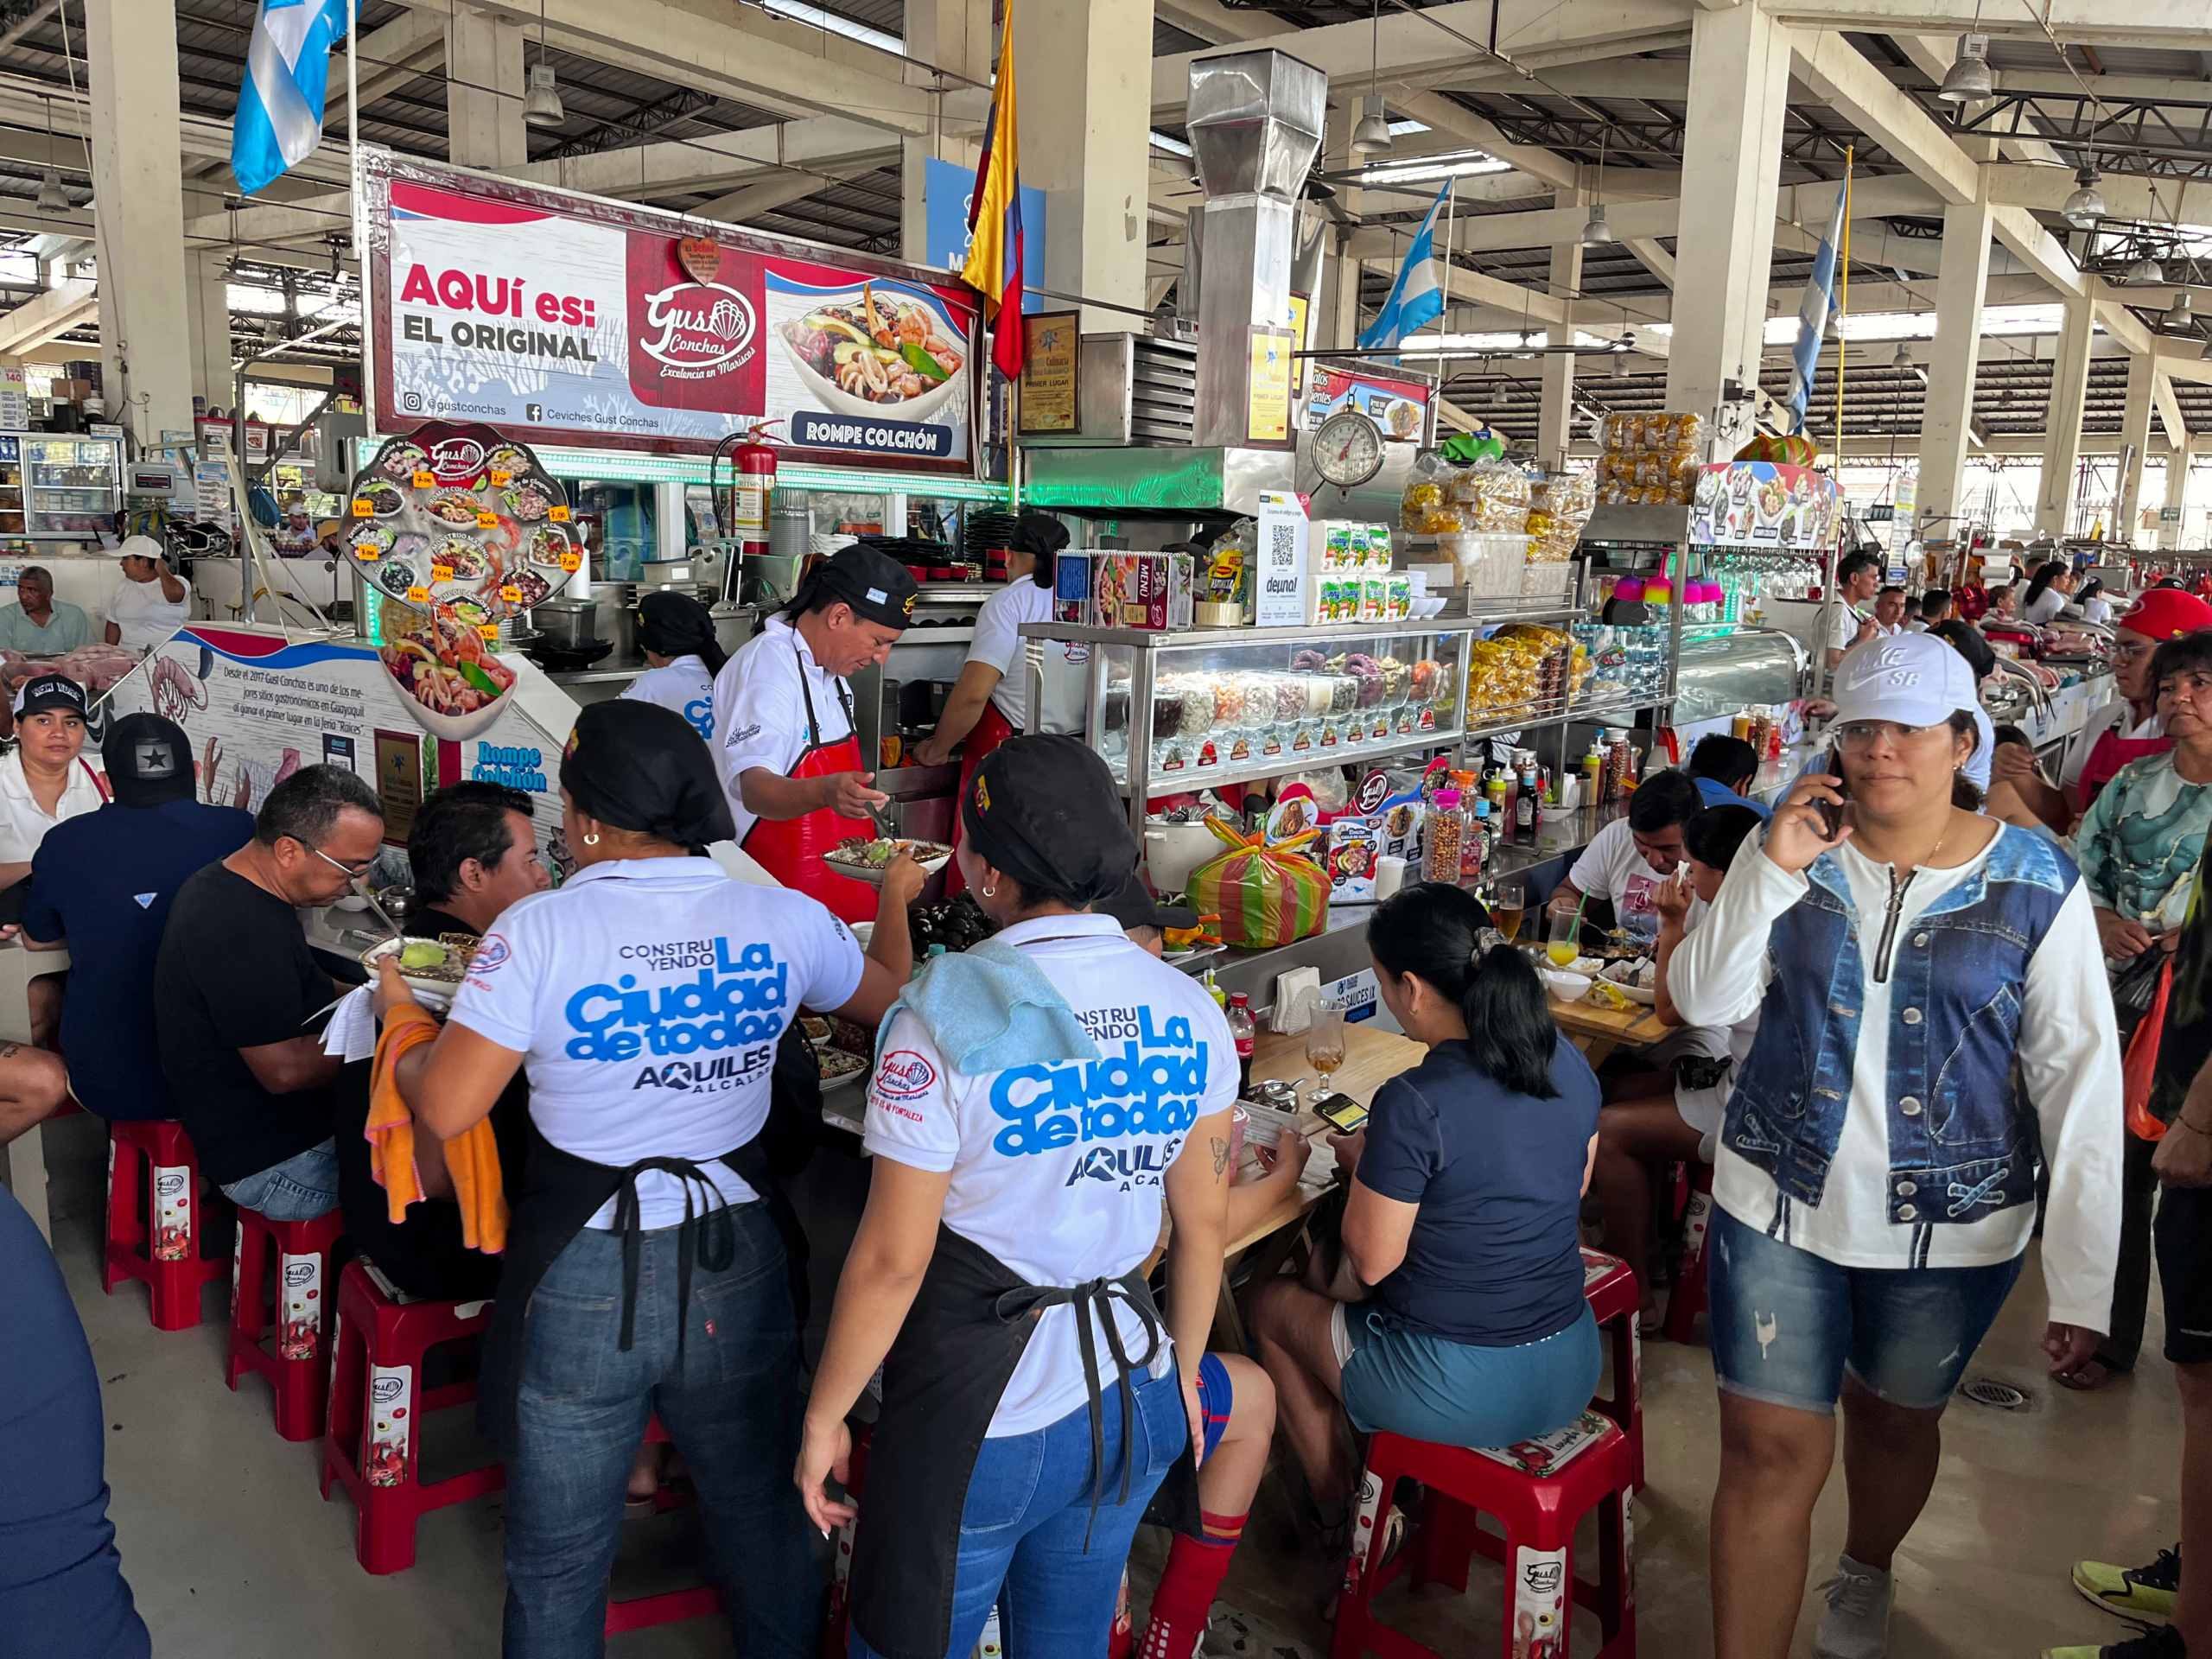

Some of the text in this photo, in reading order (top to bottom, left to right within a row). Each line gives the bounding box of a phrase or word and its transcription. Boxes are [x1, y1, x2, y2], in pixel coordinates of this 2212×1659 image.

[535, 292, 595, 328] es:
[404, 314, 598, 362] EL ORIGINAL
[670, 334, 726, 356] Conchas
[660, 346, 757, 379] Excelencia en Mariscos
[6, 373, 22, 382] 140
[427, 398, 507, 416] @gustconchas
[547, 409, 659, 429] Ceviches Gust Conchas
[806, 422, 938, 451] ROMPE COLCHÓN
[380, 443, 396, 461] Ceviche
[485, 443, 504, 458] Ceviche
[429, 486, 449, 505] ROMPE
[355, 505, 372, 513] 7.00
[550, 510, 566, 518] 7.00
[348, 521, 364, 538] Ceviche
[431, 532, 490, 560] MONSTRUO MARINO
[562, 557, 576, 567] 7.00
[1140, 563, 1149, 598] MENÚ
[1266, 576, 1298, 594] deuna!
[461, 588, 493, 616] LANGOSTA
[1855, 646, 1907, 672] NIKE
[224, 667, 364, 698] Desde el 2017 Gust Conchas es uno de los me-
[1887, 671, 1922, 687] SB
[243, 687, 257, 700] jores
[258, 689, 273, 702] sitios
[275, 692, 320, 709] gastronómicos
[321, 702, 329, 712] en
[233, 702, 336, 731] al ganar el primer lugar en la feria
[478, 741, 542, 772] Rompe
[472, 764, 548, 792] Colchón
[620, 938, 713, 960] CONSTRU
[715, 936, 774, 975] La
[646, 953, 715, 972] YENDO
[566, 963, 788, 1034] Ciudad
[1346, 987, 1369, 1008] SAUCES
[1136, 1005, 1193, 1048] La
[566, 1027, 642, 1063] de
[632, 1044, 772, 1091] AQUILES
[692, 1065, 771, 1095] ALCALDE
[883, 1074, 910, 1091] Conchas
[892, 1104, 923, 1123] FORTALEZA
[993, 1112, 1078, 1157] de
[1065, 1137, 1182, 1187] AQUILS
